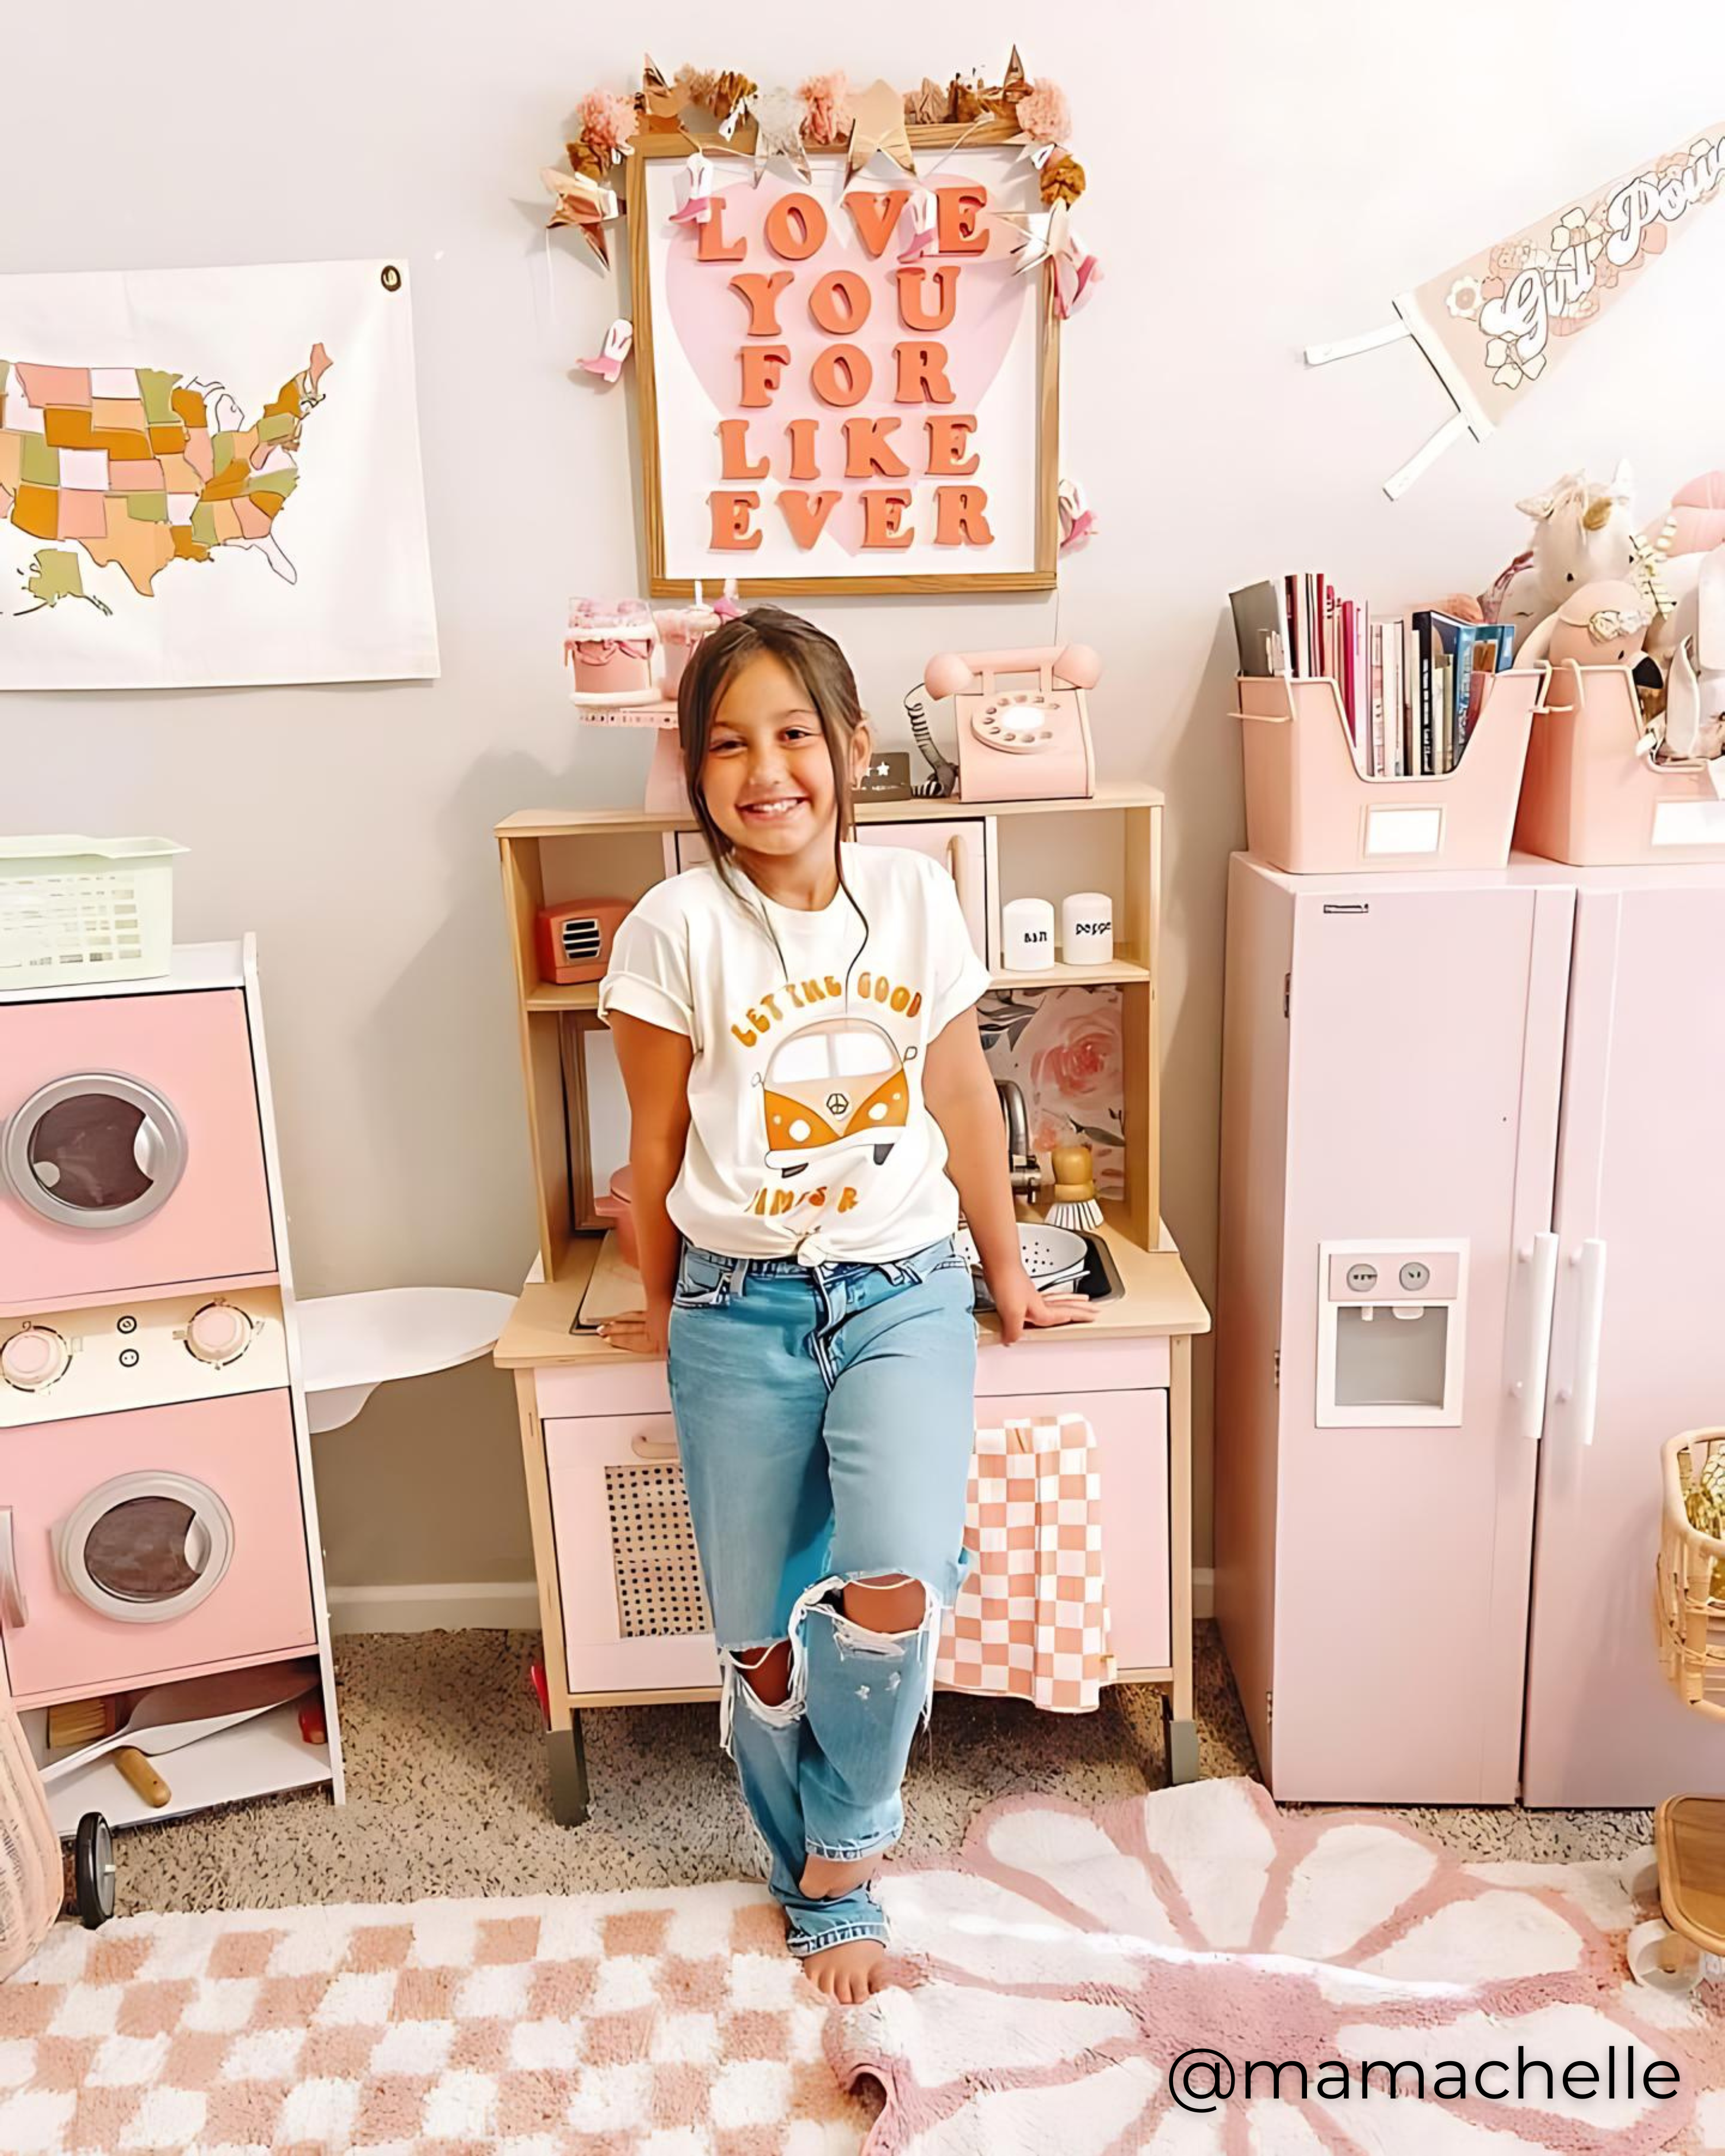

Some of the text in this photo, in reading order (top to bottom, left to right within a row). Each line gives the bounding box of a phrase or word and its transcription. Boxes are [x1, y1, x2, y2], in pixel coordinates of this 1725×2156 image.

[697, 186, 990, 262] LOVE
[727, 266, 961, 336] YOU
[1479, 242, 1596, 365] Girl
[736, 341, 957, 408] FOR
[716, 414, 980, 481] LIKE
[707, 485, 995, 550] EVER
[730, 993, 783, 1048] LET
